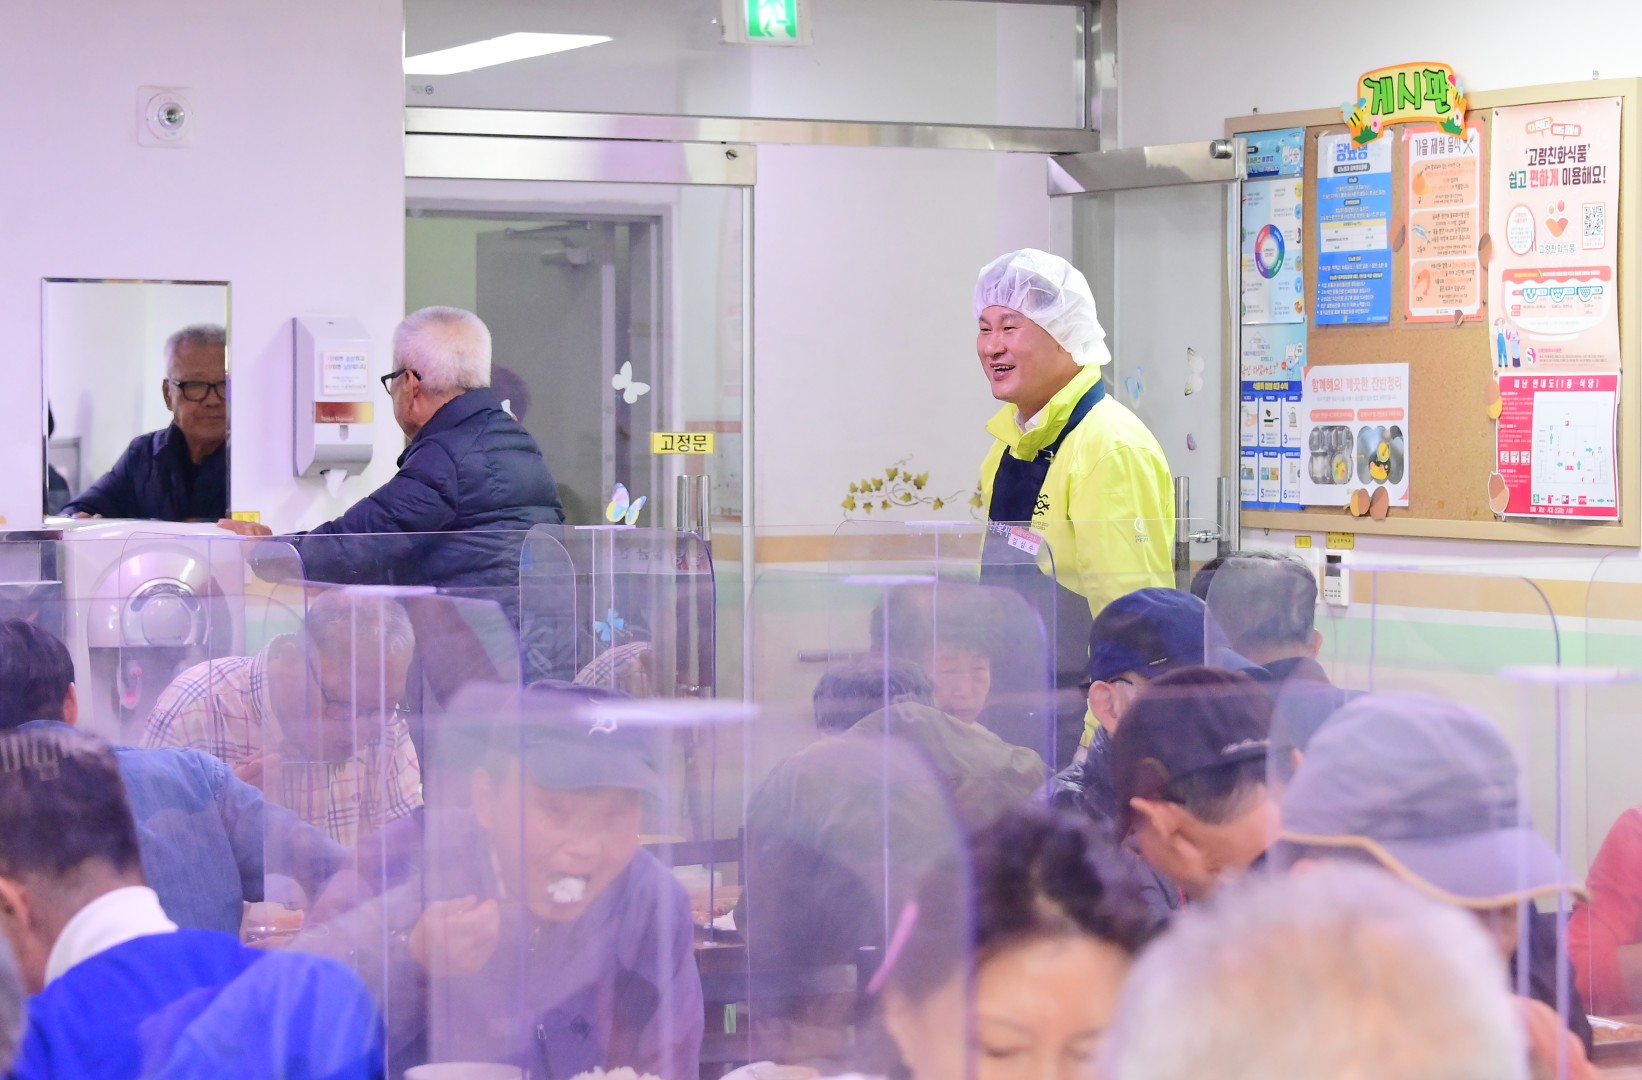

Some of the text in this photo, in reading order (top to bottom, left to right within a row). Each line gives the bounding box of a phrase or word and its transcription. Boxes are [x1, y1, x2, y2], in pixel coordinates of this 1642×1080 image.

[1363, 68, 1451, 115] 게시판
[1415, 139, 1428, 156] 가을
[1431, 137, 1445, 155] 제철
[1509, 165, 1606, 189] 쉽고 편하게 이용해요!
[1312, 376, 1402, 393] 함께해요! 깨끗한 잔반정리
[1514, 379, 1528, 389] 피난
[661, 434, 708, 452] 고정문
